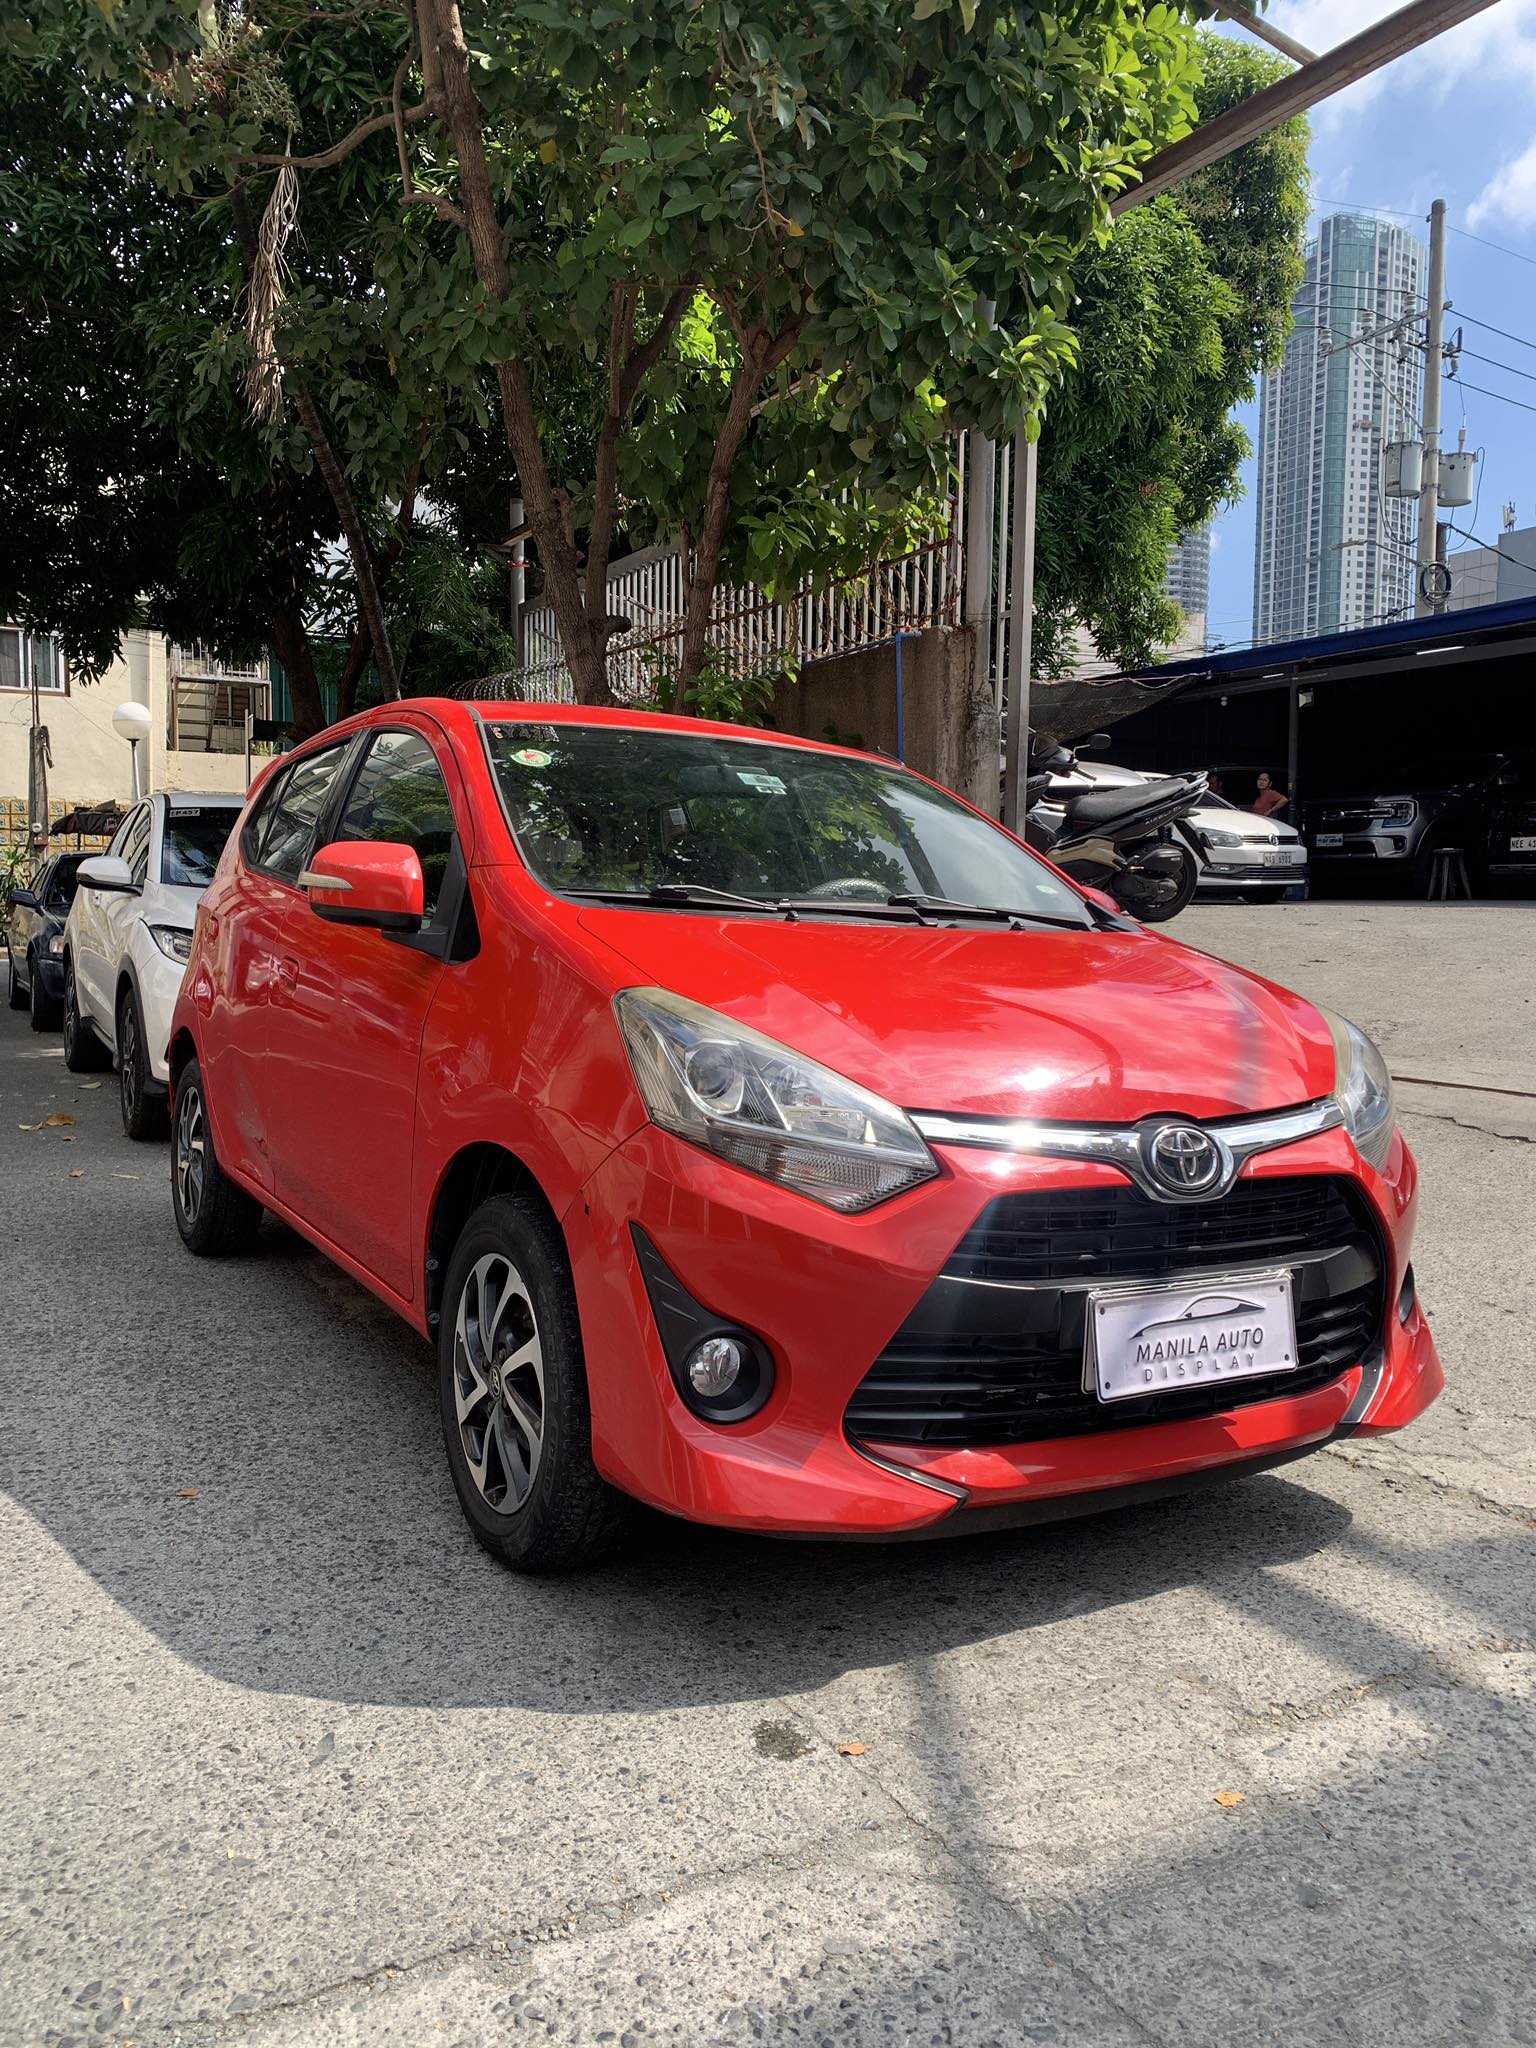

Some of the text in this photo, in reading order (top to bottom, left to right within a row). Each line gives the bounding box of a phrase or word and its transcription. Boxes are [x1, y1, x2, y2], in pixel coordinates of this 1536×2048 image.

[1512, 839, 1524, 849] NEE
[1136, 1327, 1264, 1363] MANILA AUTO
[1144, 1353, 1255, 1382] DISPLAY
